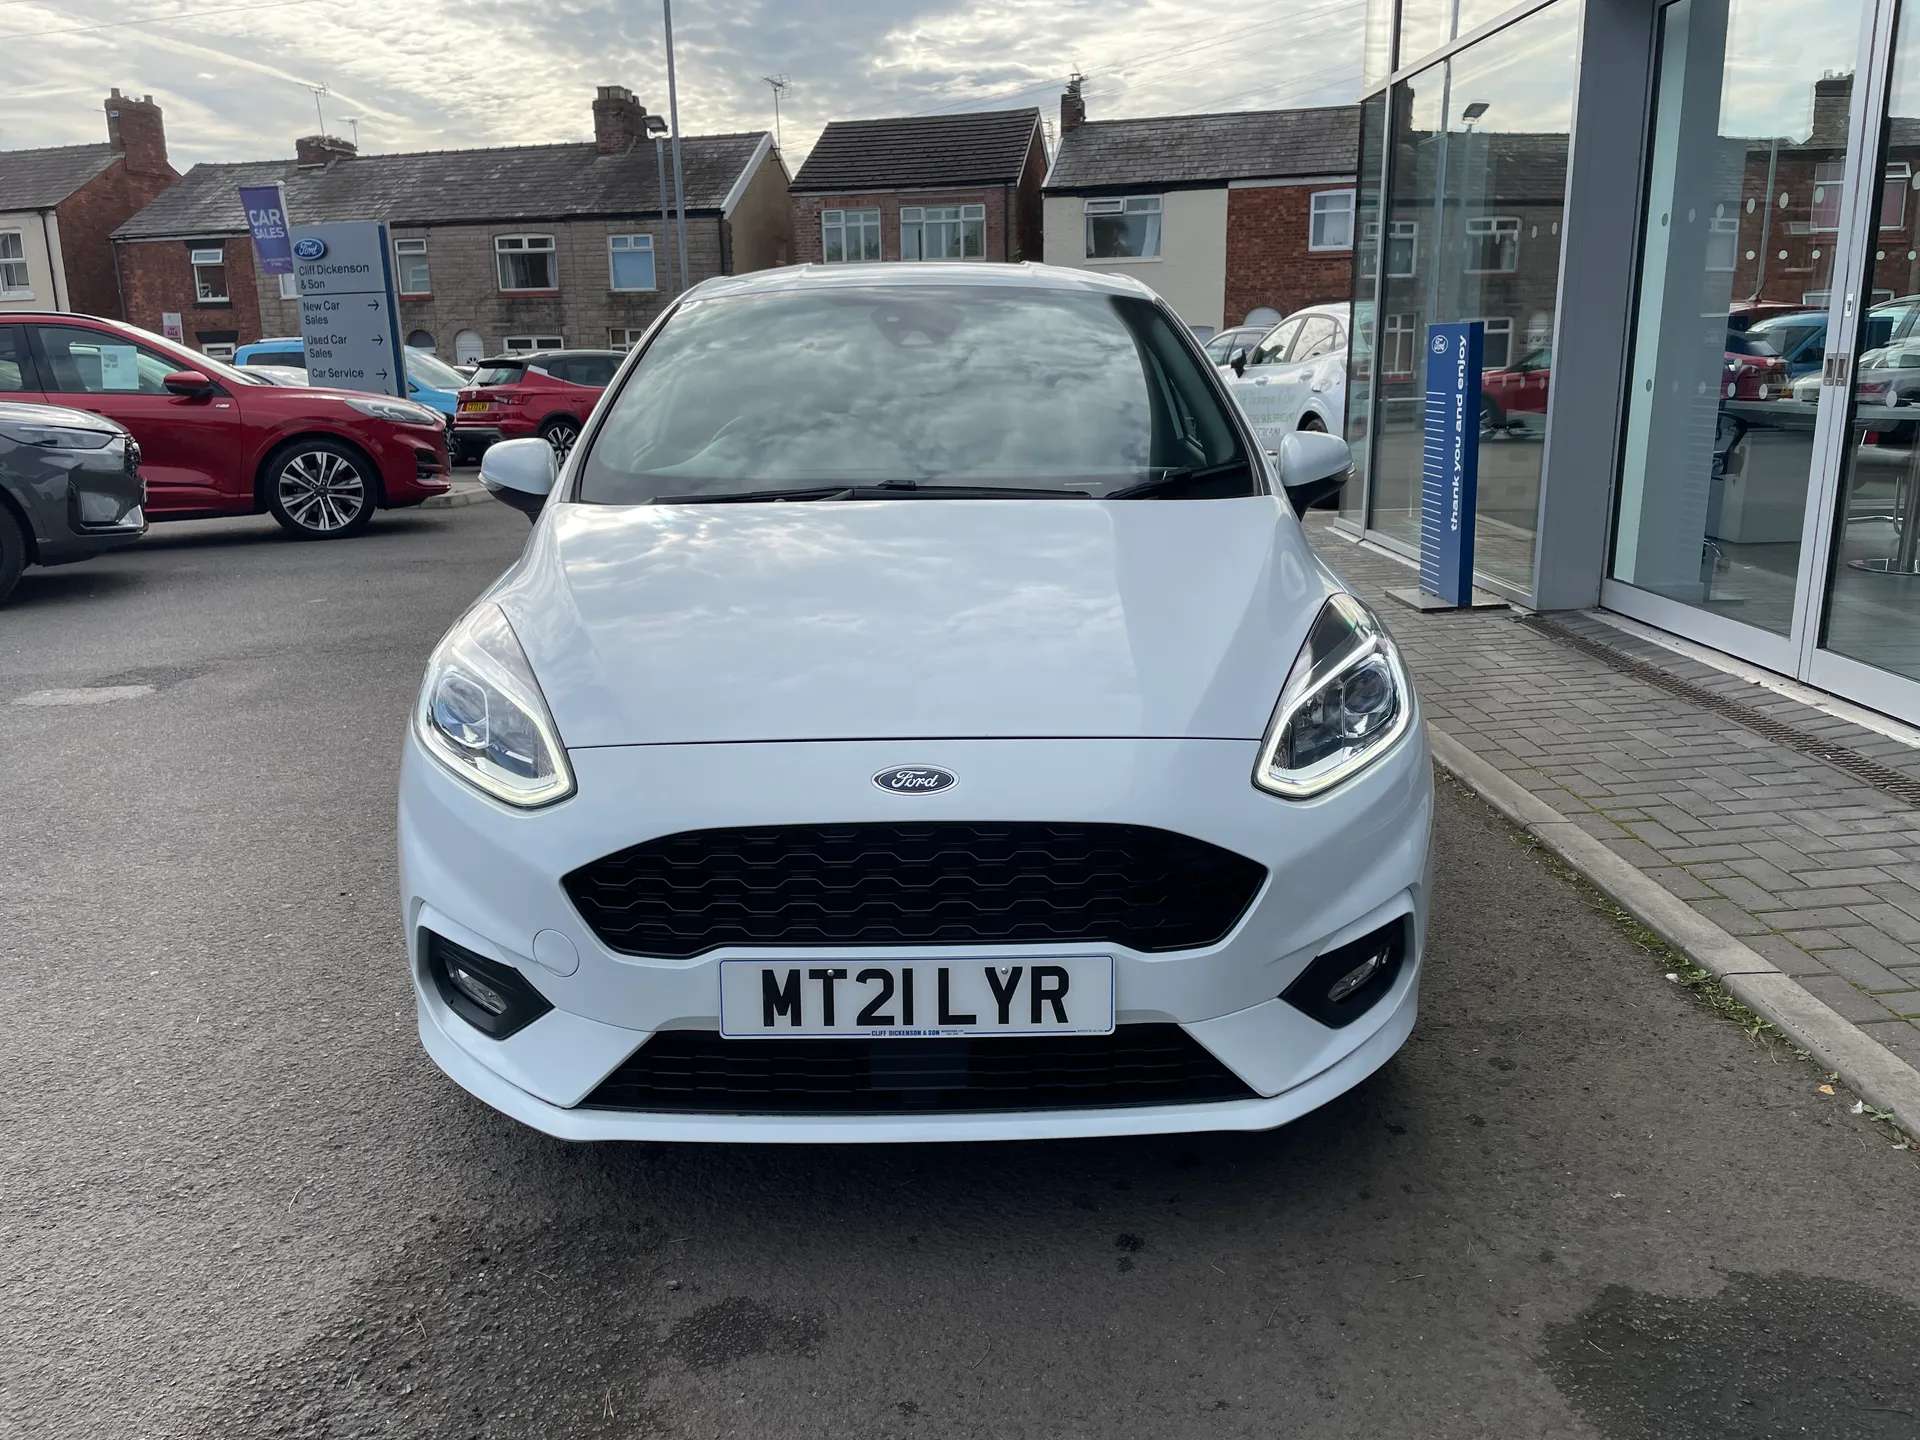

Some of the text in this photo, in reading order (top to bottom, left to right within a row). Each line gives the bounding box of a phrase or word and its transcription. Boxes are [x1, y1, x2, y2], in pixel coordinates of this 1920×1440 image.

[250, 208, 281, 226] CAR
[254, 227, 285, 239] SALES
[297, 241, 320, 256] Ford
[299, 263, 370, 276] Cliff Dickenson
[301, 279, 325, 289] & Son
[303, 301, 340, 312] New Car
[305, 315, 329, 325] Sales
[307, 335, 347, 345] Used Car
[309, 348, 333, 359] Sales
[312, 368, 364, 378] Car Service
[1450, 335, 1468, 531] thank you and enjoy
[761, 965, 1070, 1027] MT21 LYR
